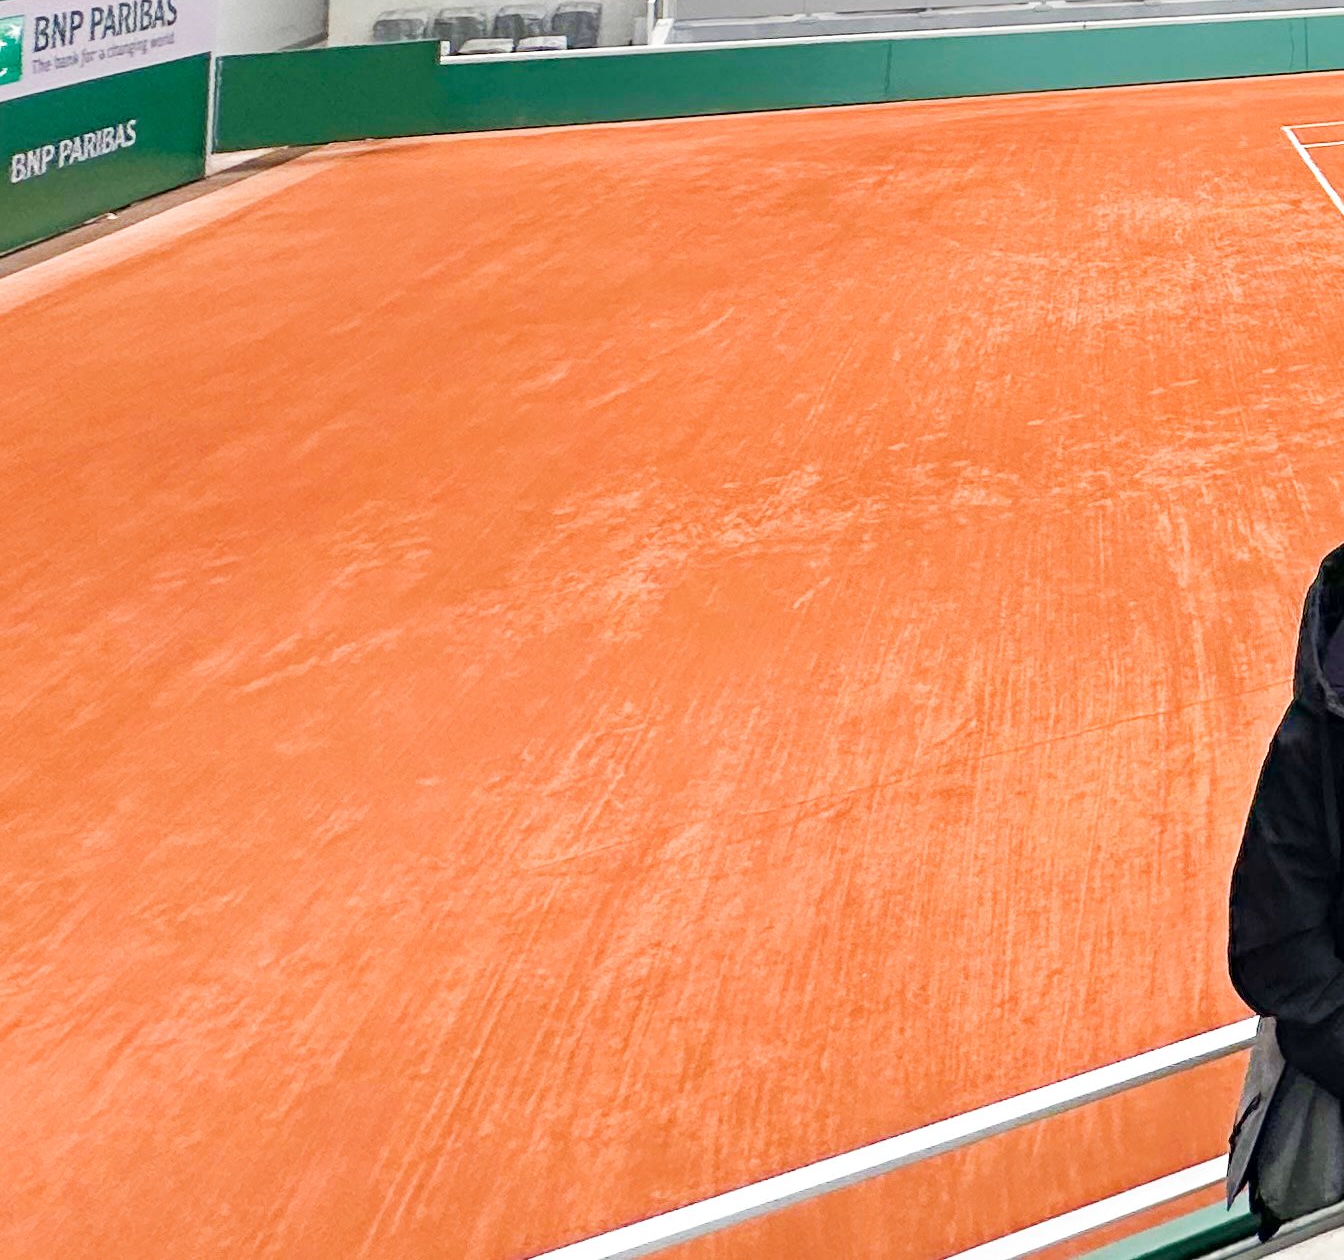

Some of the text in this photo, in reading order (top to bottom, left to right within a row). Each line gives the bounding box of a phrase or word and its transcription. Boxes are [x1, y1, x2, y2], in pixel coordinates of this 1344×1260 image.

[32, 10, 84, 53] BNP
[32, 56, 51, 74] The
[80, 48, 98, 68] for
[98, 49, 105, 60] a
[10, 119, 137, 183] BNP PARIBAS
